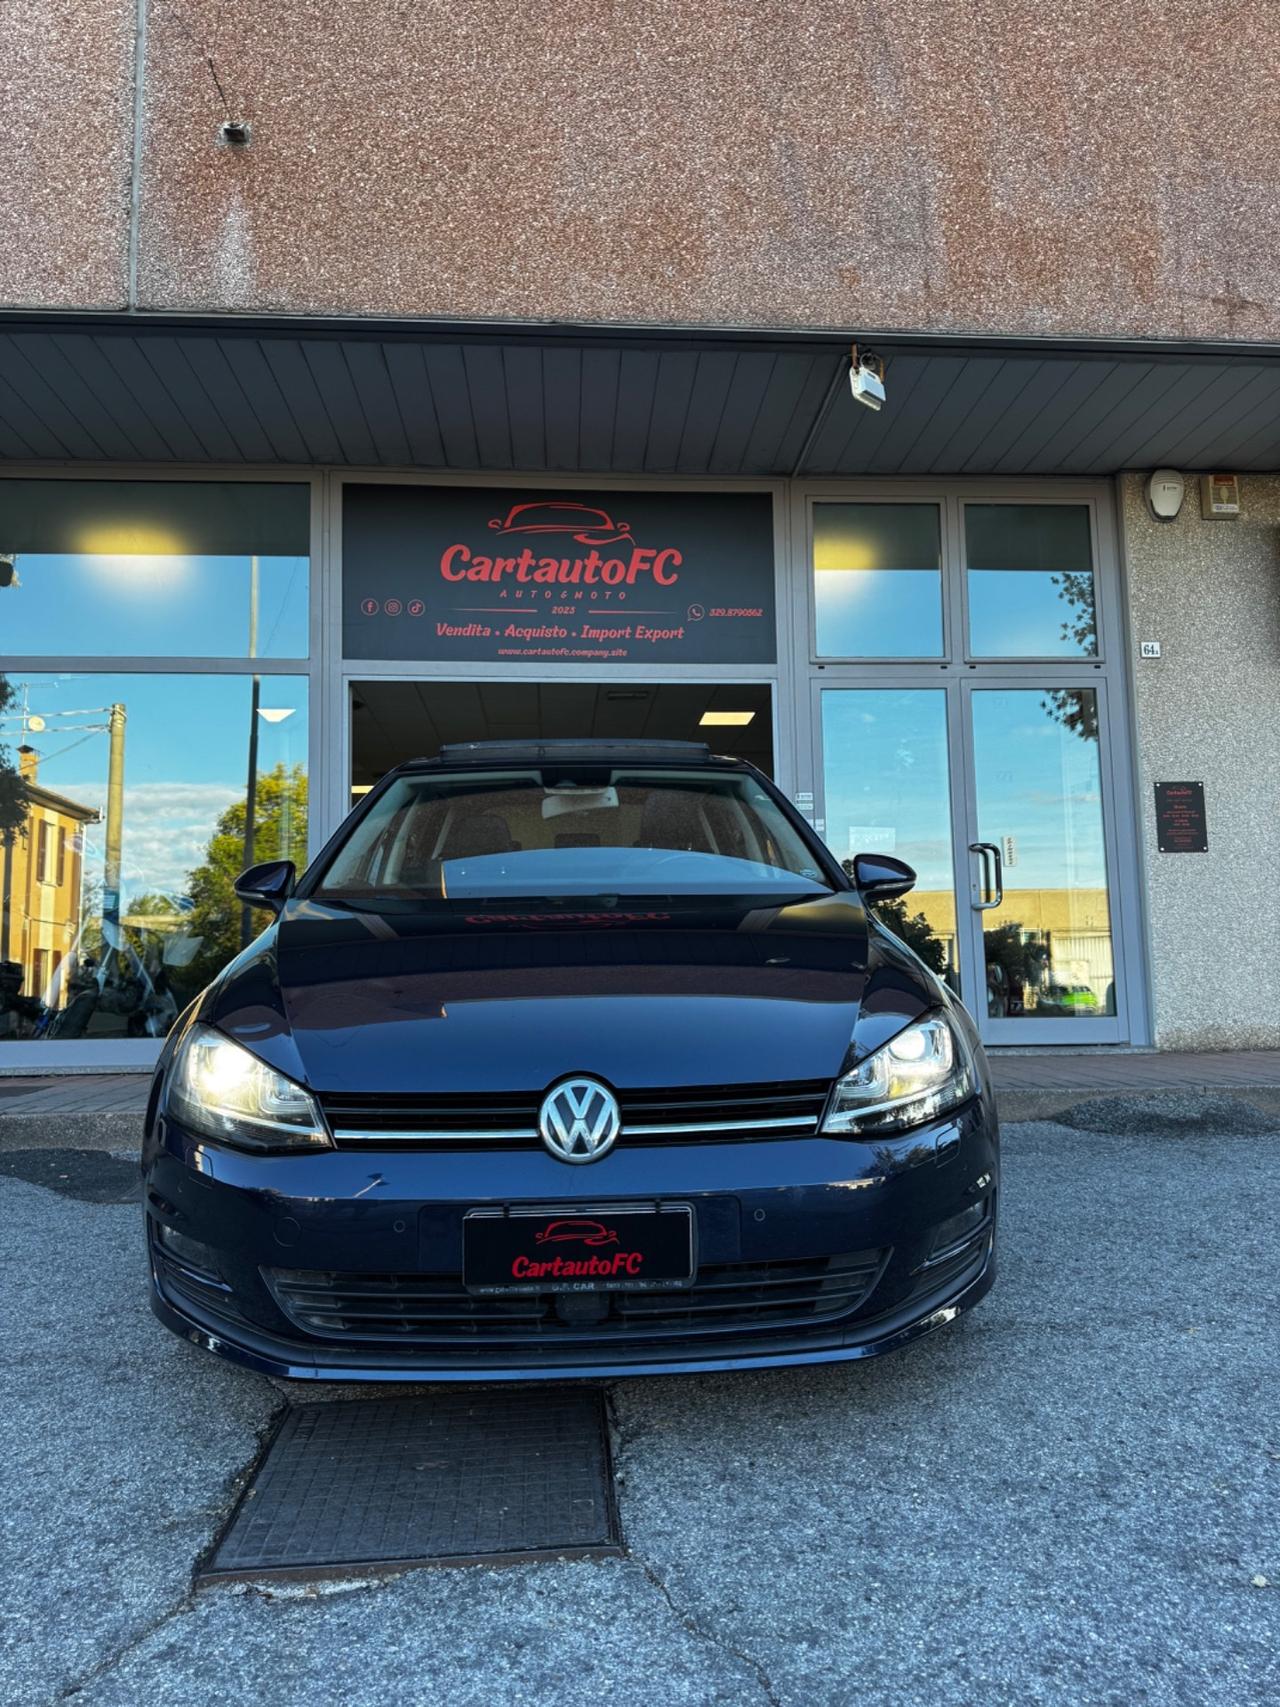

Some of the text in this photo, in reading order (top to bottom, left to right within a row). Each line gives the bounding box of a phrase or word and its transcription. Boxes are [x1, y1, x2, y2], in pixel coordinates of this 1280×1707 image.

[440, 544, 682, 586] CartautoFC
[436, 622, 684, 642] Vendita Acquisto Import Export
[511, 1252, 643, 1278] CartautoFC
